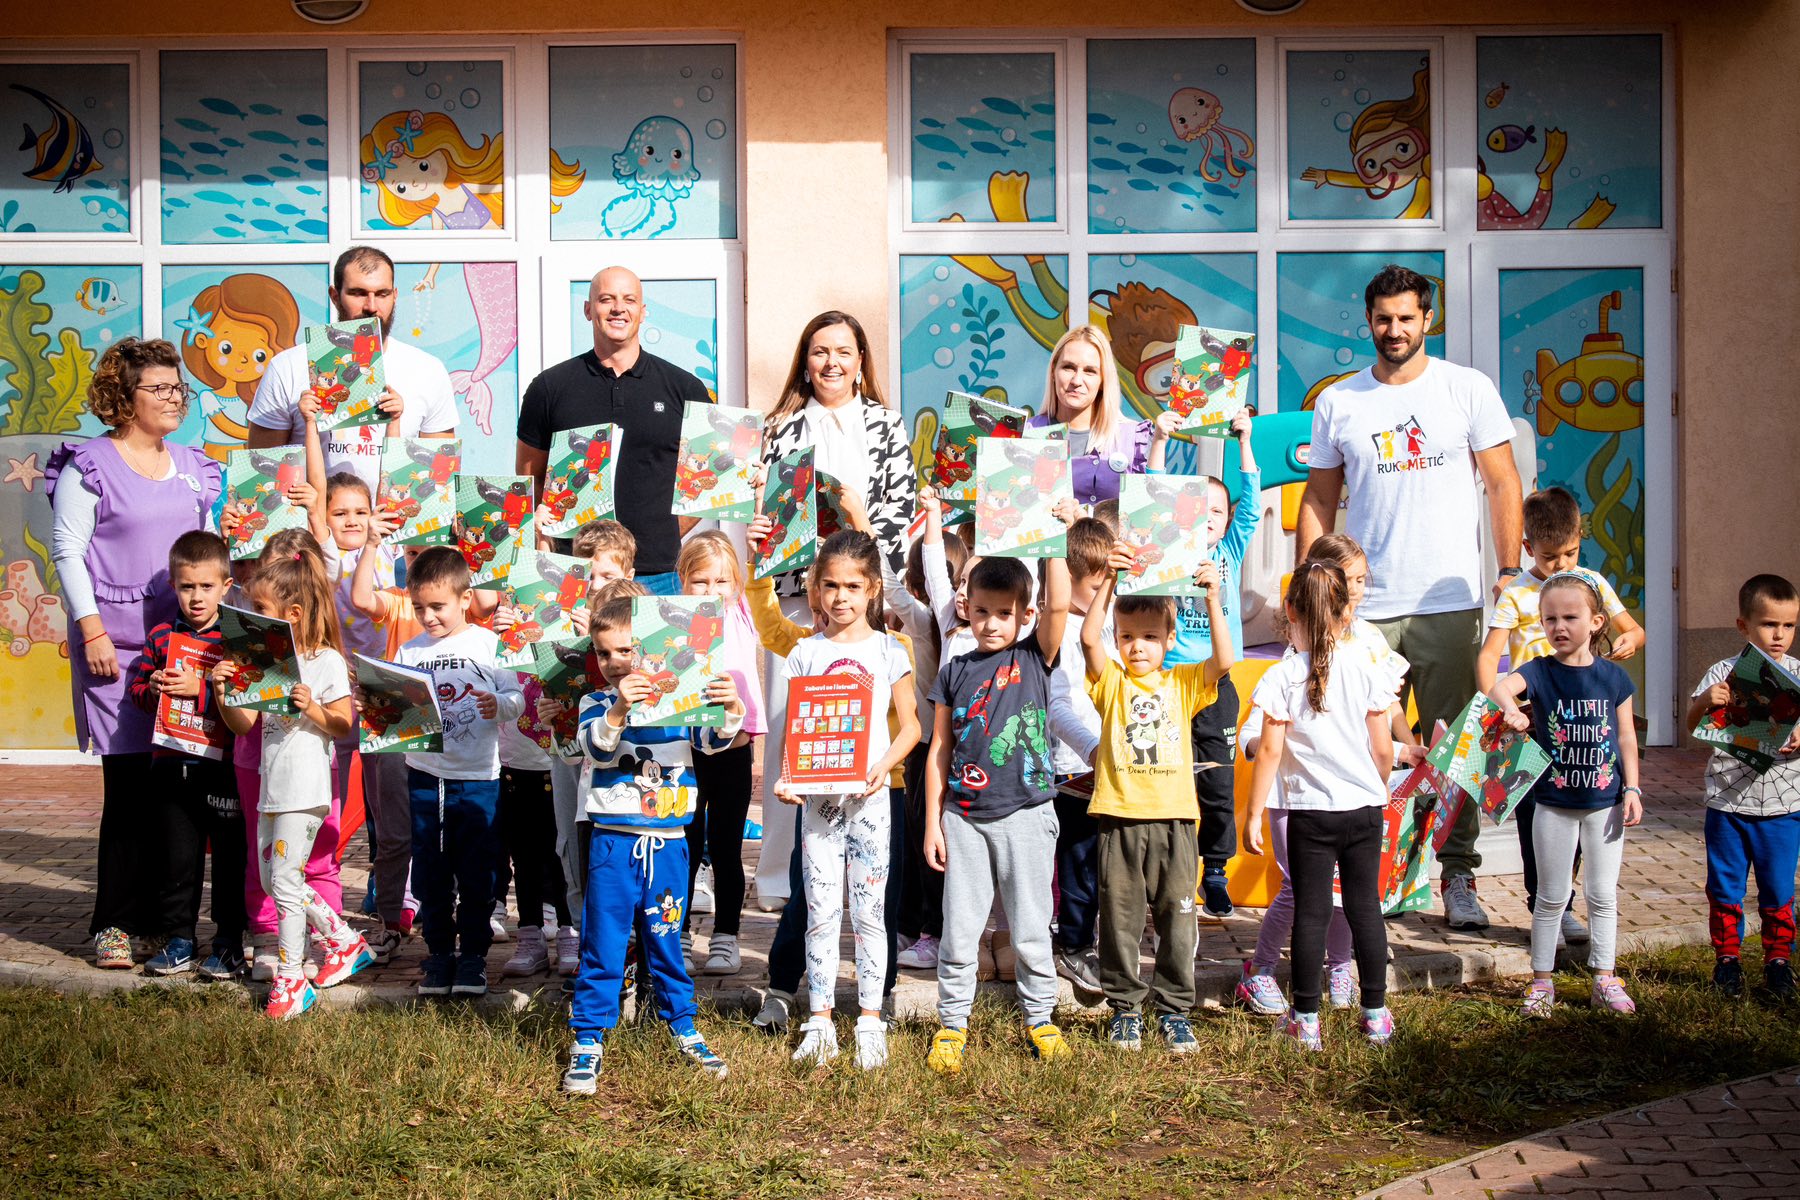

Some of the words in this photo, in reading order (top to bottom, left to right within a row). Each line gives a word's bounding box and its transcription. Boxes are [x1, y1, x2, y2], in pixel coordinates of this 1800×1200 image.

[1570, 699, 1609, 718] LITTLE
[1563, 723, 1604, 743] THING
[1560, 746, 1605, 766] CALLED
[1563, 769, 1599, 789] LOVE
